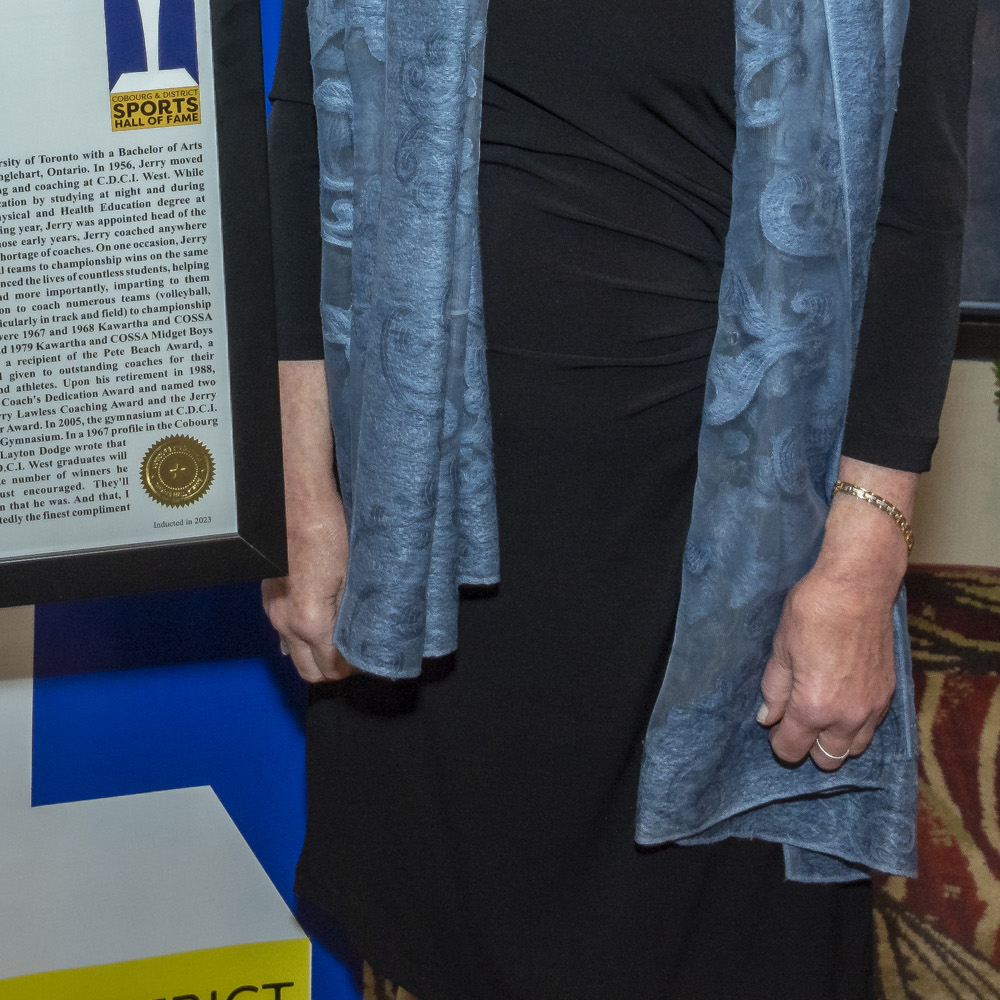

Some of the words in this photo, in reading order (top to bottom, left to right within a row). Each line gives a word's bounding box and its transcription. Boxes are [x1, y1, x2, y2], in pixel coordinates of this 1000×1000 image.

[112, 93, 153, 102] COBOURG
[163, 89, 198, 98] DISTRICT
[113, 97, 198, 118] SPORTS
[115, 118, 145, 128] HALL
[148, 116, 164, 125] OF
[167, 113, 198, 124] FAME
[24, 155, 35, 165] of
[37, 152, 78, 163] Toronto
[82, 149, 104, 159] with
[118, 144, 163, 156] Bachelor
[166, 142, 178, 152] of
[180, 141, 202, 151] Arts
[11, 182, 31, 193] and
[34, 179, 79, 191] coaching
[83, 177, 93, 186] at
[96, 173, 138, 185] C.D.C.I.
[141, 171, 170, 181] West.
[173, 167, 204, 178] While
[35, 207, 54, 218] and
[60, 204, 94, 215] Health
[99, 199, 151, 212] Education
[156, 197, 190, 208] degree
[195, 194, 205, 203] at
[20, 235, 46, 246] early
[49, 234, 80, 245] years,
[83, 230, 110, 240] Jerry
[113, 224, 154, 237] coached
[158, 221, 207, 234] anywhere
[6, 264, 36, 274] teams
[38, 262, 49, 271] to
[50, 254, 122, 269] championship
[124, 252, 147, 262] wins
[164, 249, 180, 258] the
[182, 248, 208, 257] same
[14, 290, 40, 299] more
[45, 283, 108, 297] importantly,
[113, 278, 164, 291] imparting
[169, 276, 179, 284] to
[184, 274, 210, 283] them
[39, 314, 49, 324] in
[51, 311, 78, 322] track
[80, 309, 99, 320] and
[101, 307, 127, 318] field)
[129, 307, 139, 315] to
[141, 299, 211, 314] championship
[10, 342, 33, 353] 1979
[35, 338, 86, 350] Kawartha
[88, 335, 107, 345] and
[109, 331, 149, 343] COSSA
[151, 328, 186, 339] Midget
[189, 326, 213, 337] Boys
[8, 370, 35, 382] given
[42, 368, 52, 376] to
[58, 361, 118, 375] outstanding
[124, 357, 163, 368] coaches
[169, 354, 184, 363] for
[190, 351, 214, 361] their
[0, 394, 41, 406] Coach's
[44, 389, 98, 402] Dedication
[101, 385, 134, 397] Award
[138, 382, 157, 393] and
[160, 379, 194, 390] named
[197, 379, 216, 387] two
[28, 459, 52, 469] West
[56, 455, 105, 468] graduates
[108, 450, 127, 460] will
[154, 519, 184, 528] Inducted
[195, 516, 211, 524] 2023
